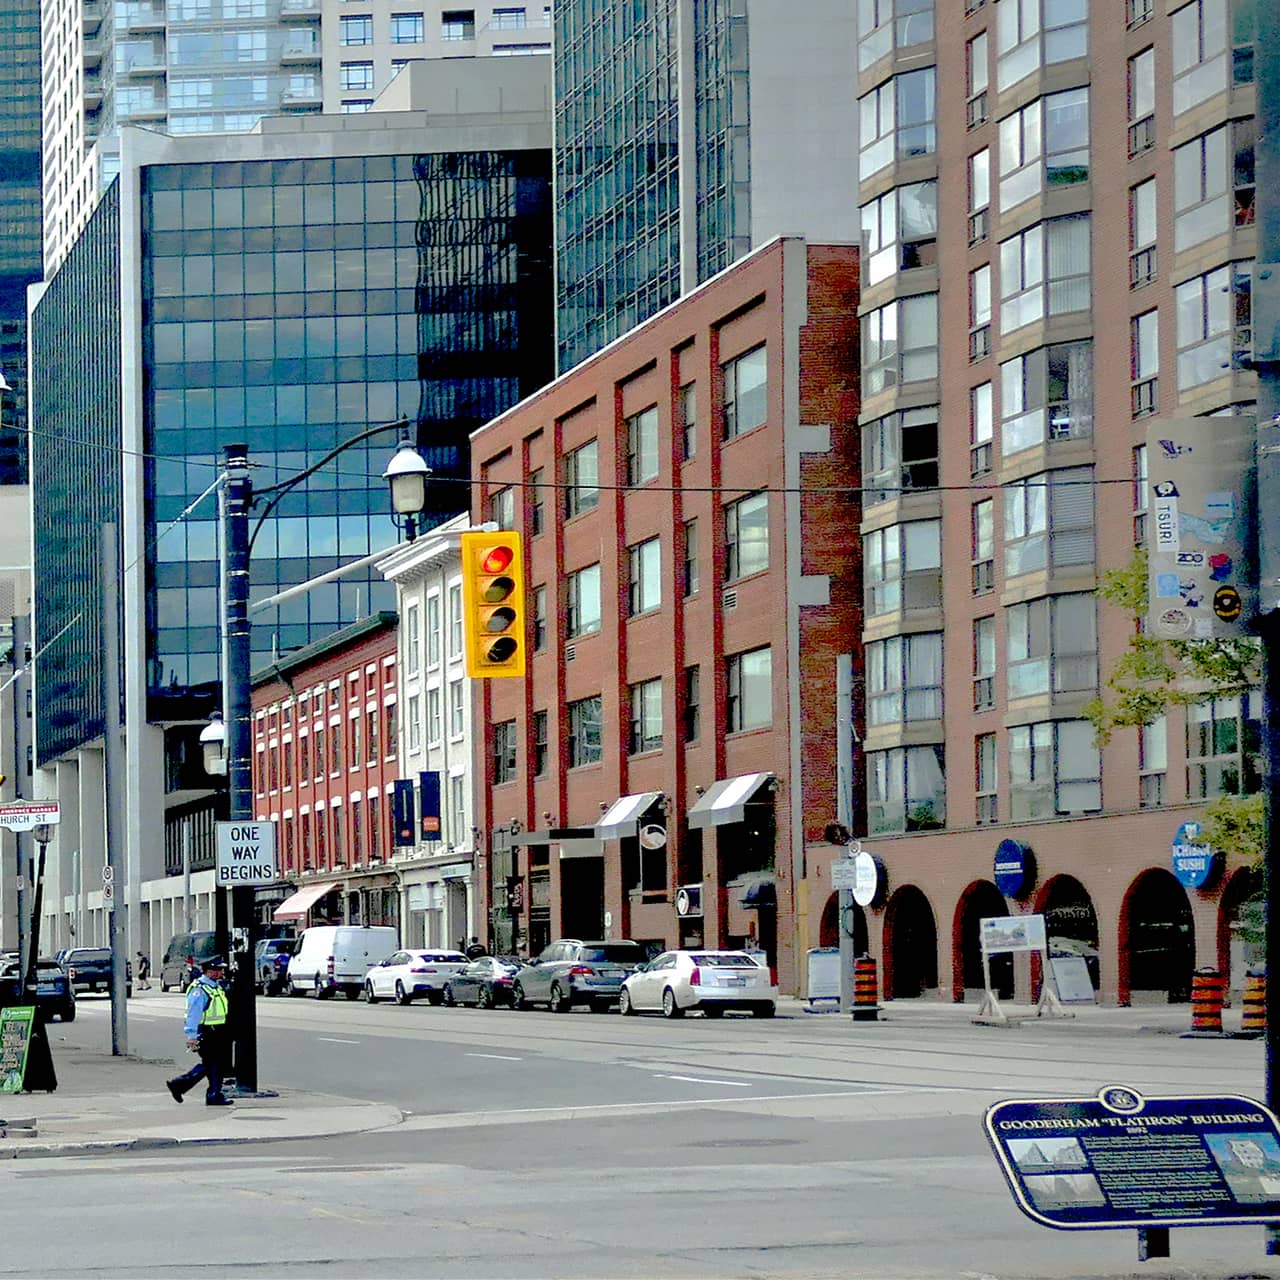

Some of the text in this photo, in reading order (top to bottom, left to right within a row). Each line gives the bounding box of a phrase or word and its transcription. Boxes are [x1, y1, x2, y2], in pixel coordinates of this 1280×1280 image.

[35, 813, 47, 823] ST
[231, 826, 260, 841] ONE
[231, 846, 260, 860] WAY
[1177, 859, 1205, 871] SUSHI
[220, 865, 273, 880] BEGINS
[1000, 1117, 1100, 1131] GOODERHAM
[1191, 1113, 1265, 1125] BUILDING
